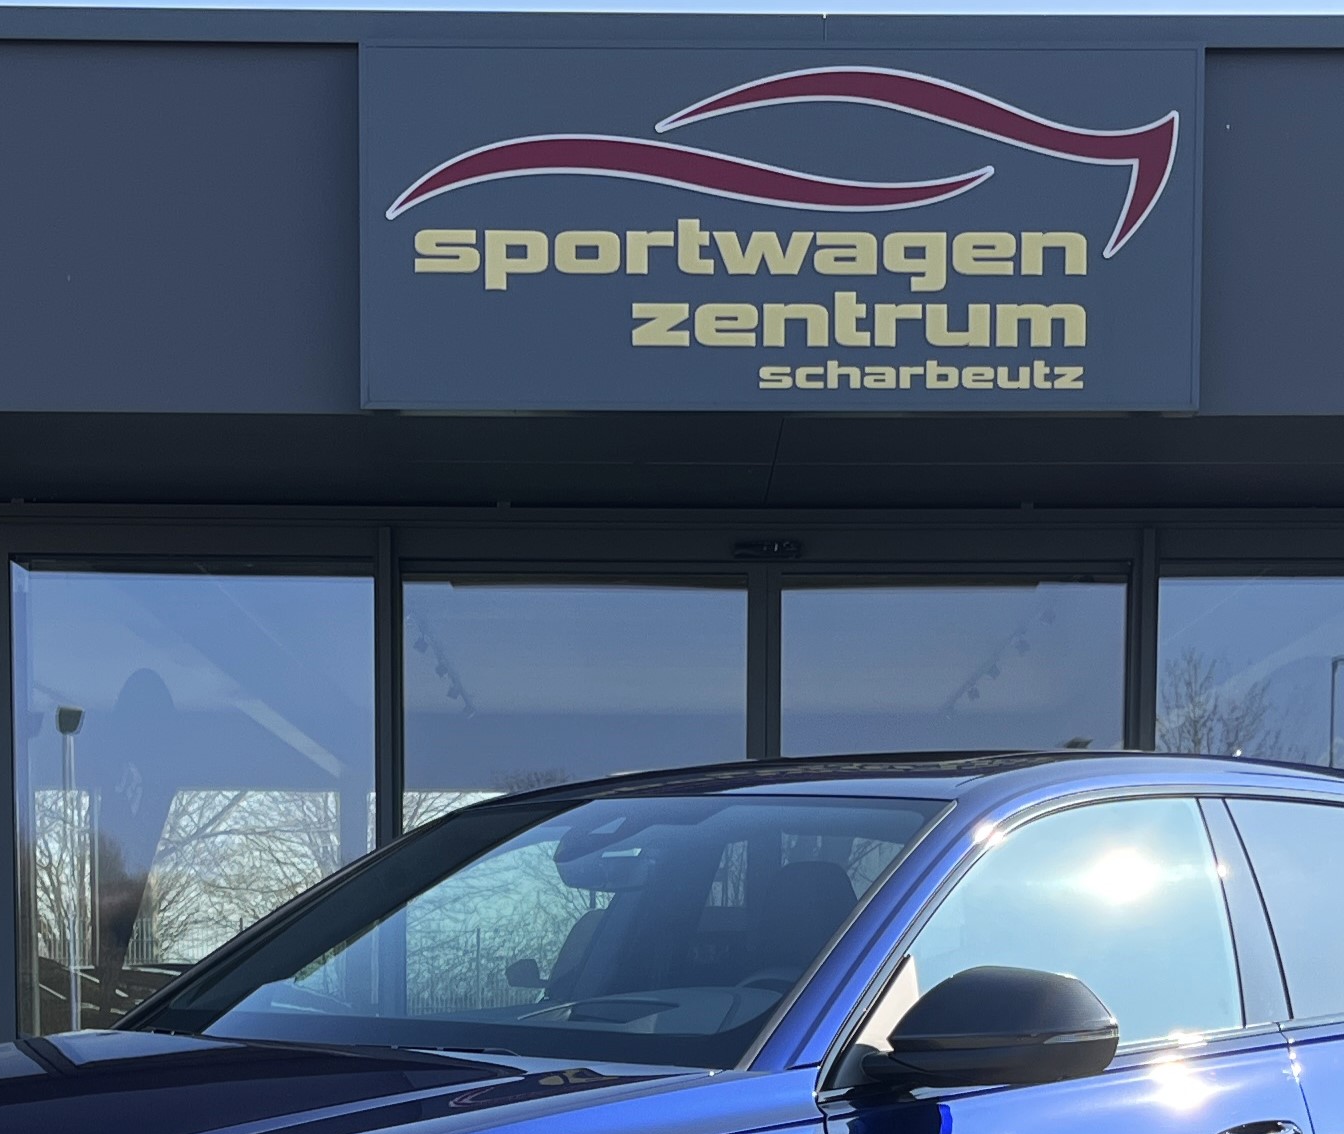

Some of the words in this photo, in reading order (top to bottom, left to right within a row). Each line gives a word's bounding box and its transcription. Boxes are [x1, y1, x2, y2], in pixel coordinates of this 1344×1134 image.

[413, 218, 1088, 292] sportwagen
[631, 291, 1088, 348] zentrum
[759, 360, 1085, 390] scharbeutz
